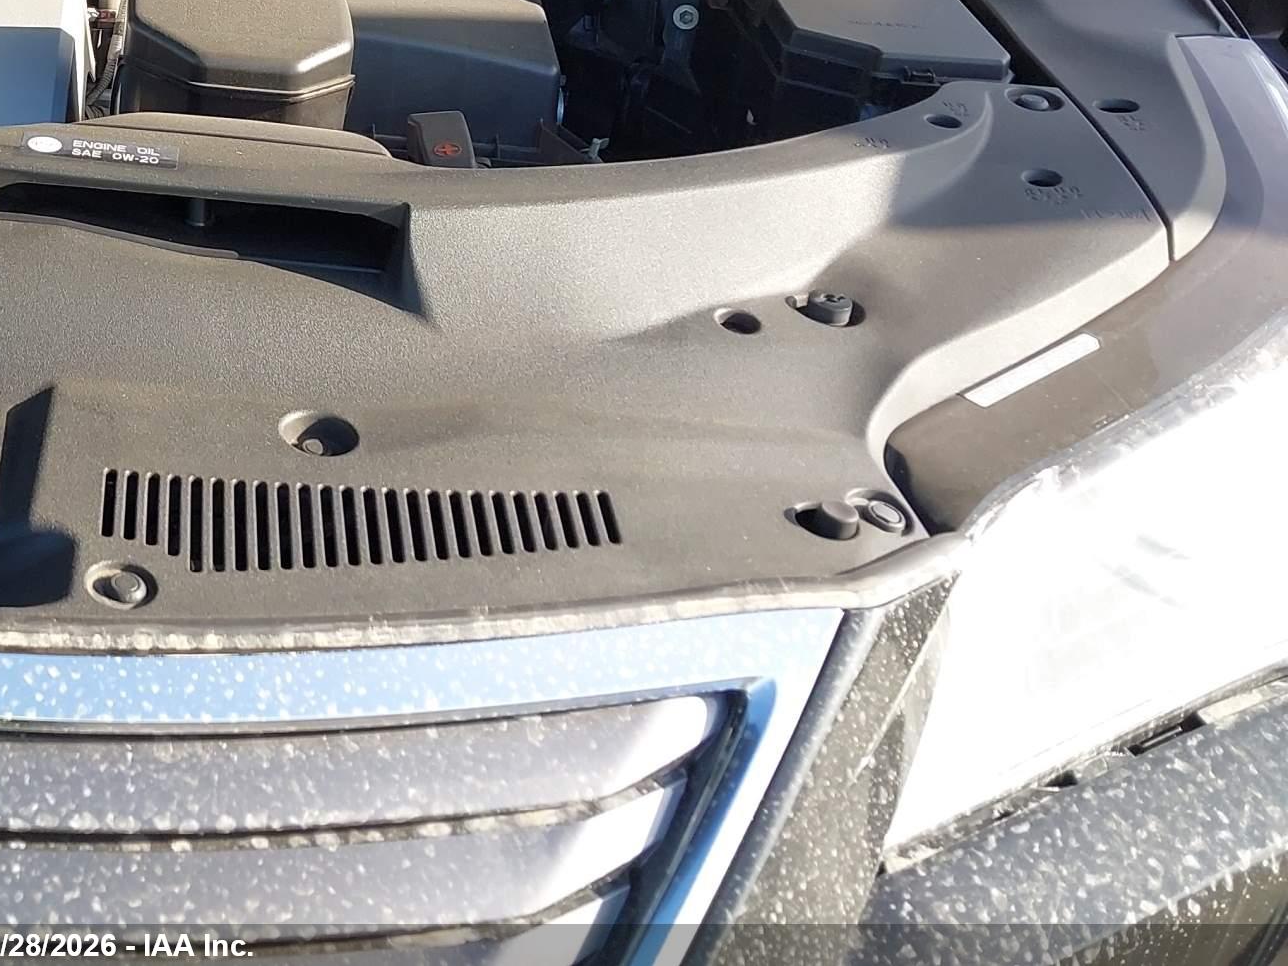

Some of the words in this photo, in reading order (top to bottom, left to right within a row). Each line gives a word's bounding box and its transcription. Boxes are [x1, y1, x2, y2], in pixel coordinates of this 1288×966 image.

[72, 139, 127, 152] ENGINE
[136, 147, 160, 156] OIL
[71, 149, 102, 158] SAE
[112, 152, 159, 164] 0W-20
